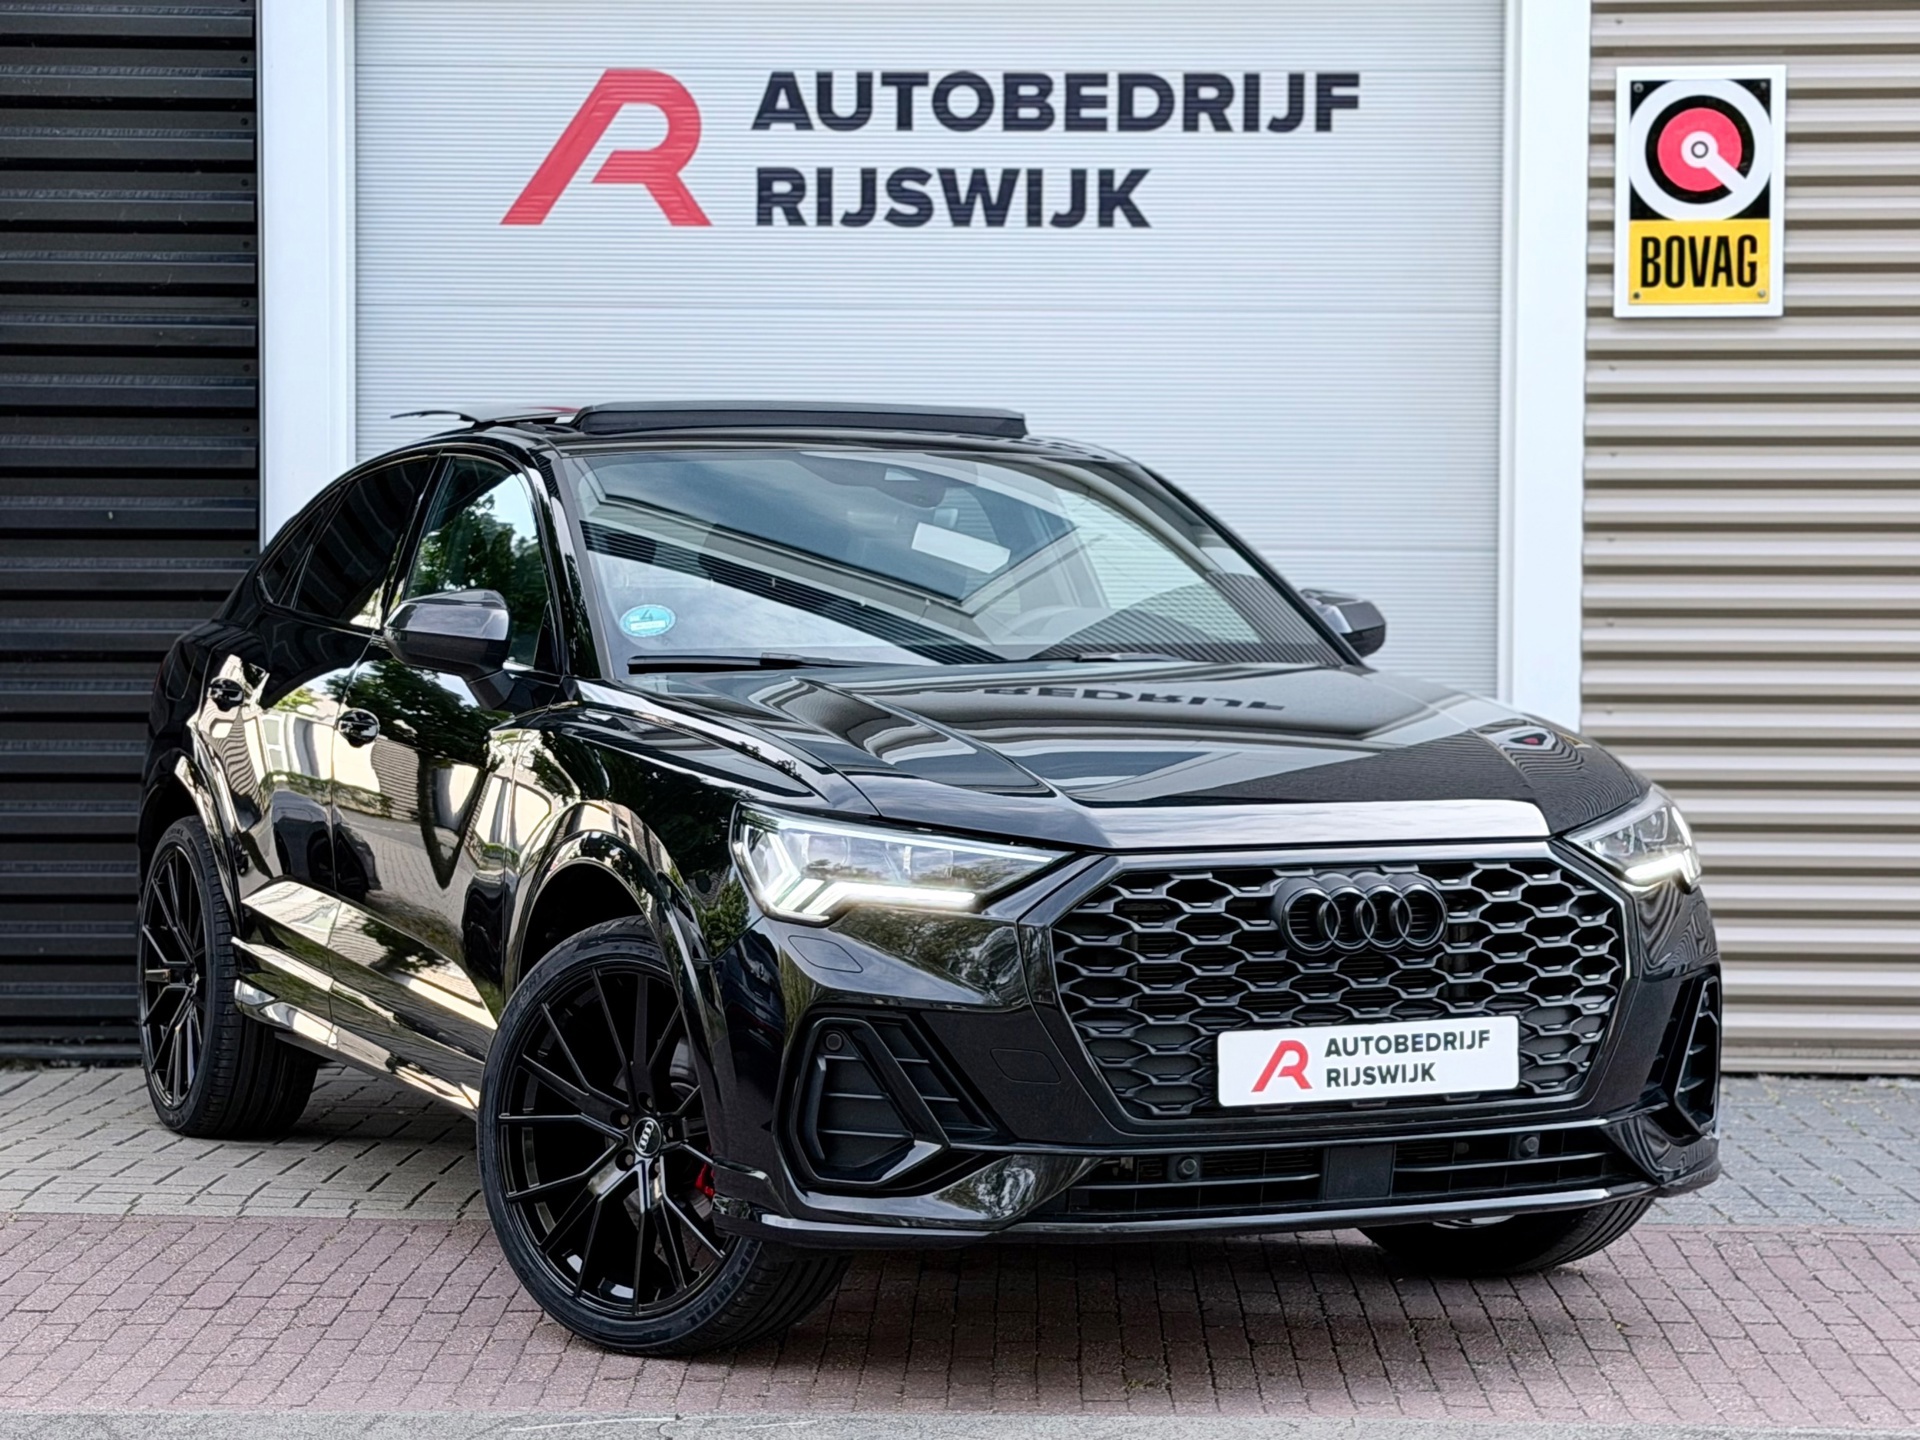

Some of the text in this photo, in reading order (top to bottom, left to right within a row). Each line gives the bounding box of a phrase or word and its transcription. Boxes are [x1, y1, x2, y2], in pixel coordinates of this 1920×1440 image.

[752, 71, 1360, 132] AUTOBEDRIJF
[755, 167, 1152, 228] RIJSWIJK
[1640, 234, 1758, 288] BOVAG
[1324, 1030, 1491, 1058] AUTOBEDRIJF
[1326, 1062, 1436, 1088] RIJSWIJK
